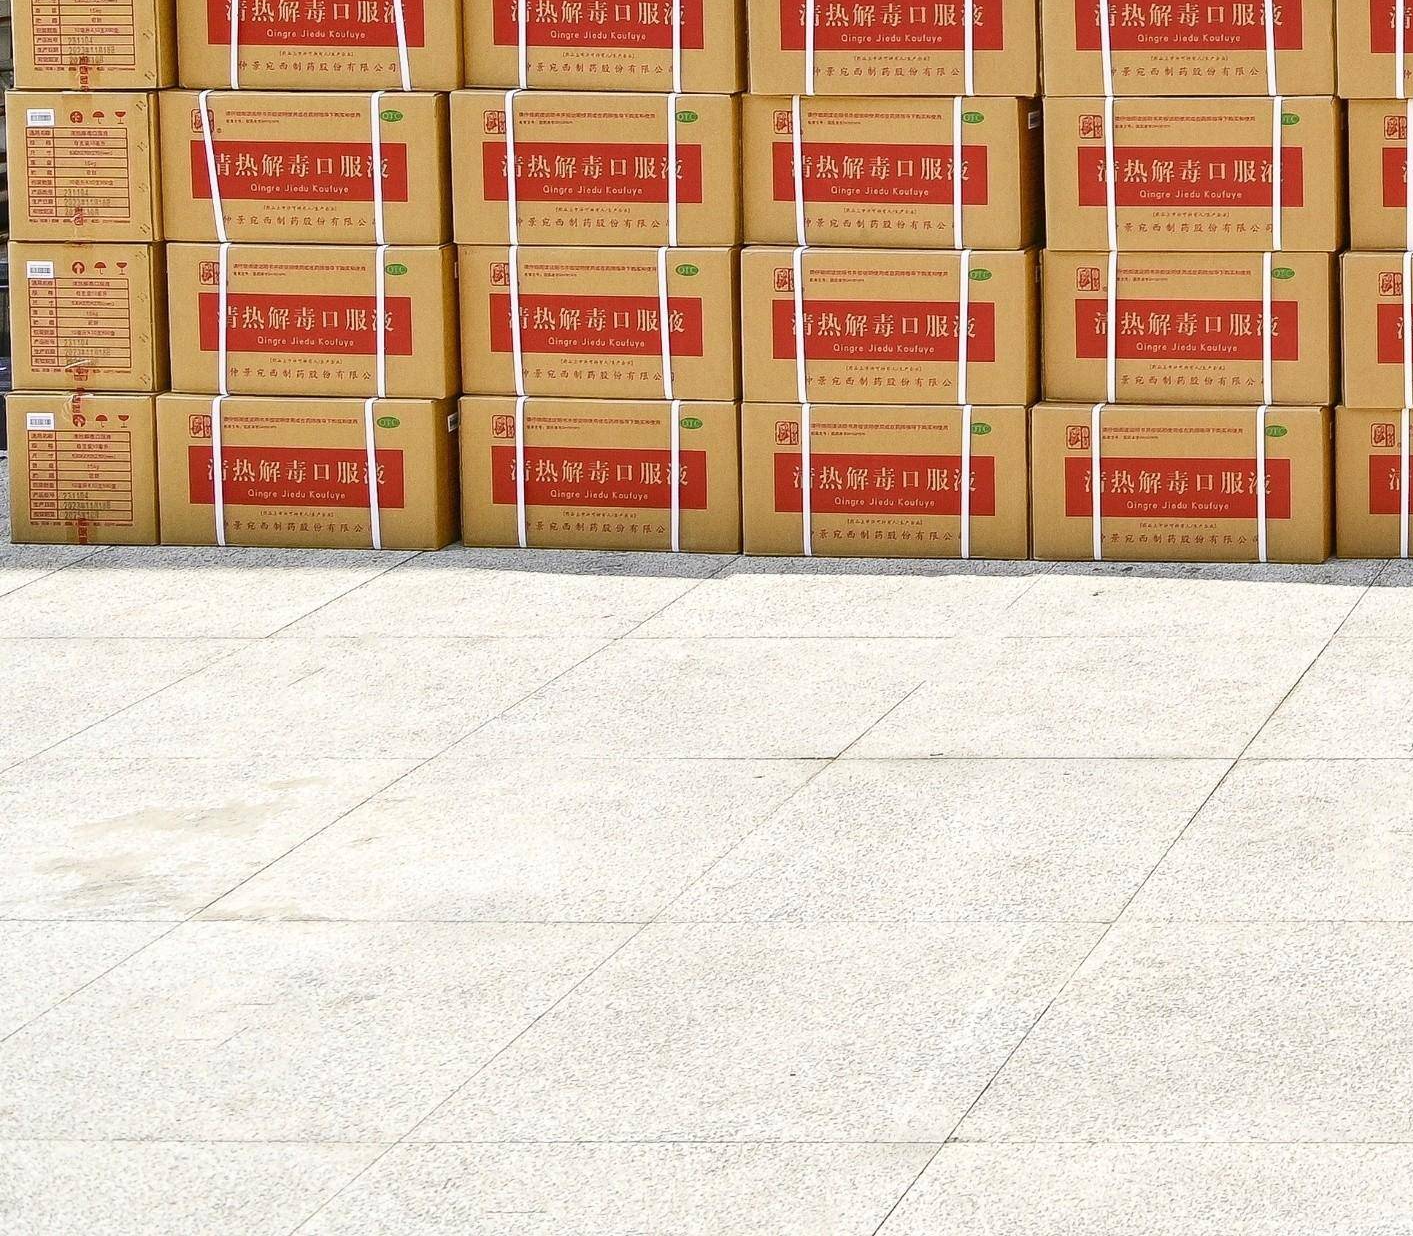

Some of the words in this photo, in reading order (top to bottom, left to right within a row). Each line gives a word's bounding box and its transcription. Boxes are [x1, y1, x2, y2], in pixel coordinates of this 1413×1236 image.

[551, 31, 579, 40] Qingre
[584, 31, 607, 39] Jiedu
[611, 32, 646, 42] Koufuye
[1138, 34, 1168, 43] Qingre
[1173, 34, 1198, 43] Jiedu
[1203, 34, 1240, 44] Koufuye
[1140, 190, 1170, 199] Qingre
[1175, 190, 1200, 198] Jiedu
[1204, 190, 1242, 199] Koufuye
[229, 369, 372, 381] 仲景宛西制药股份有限公
